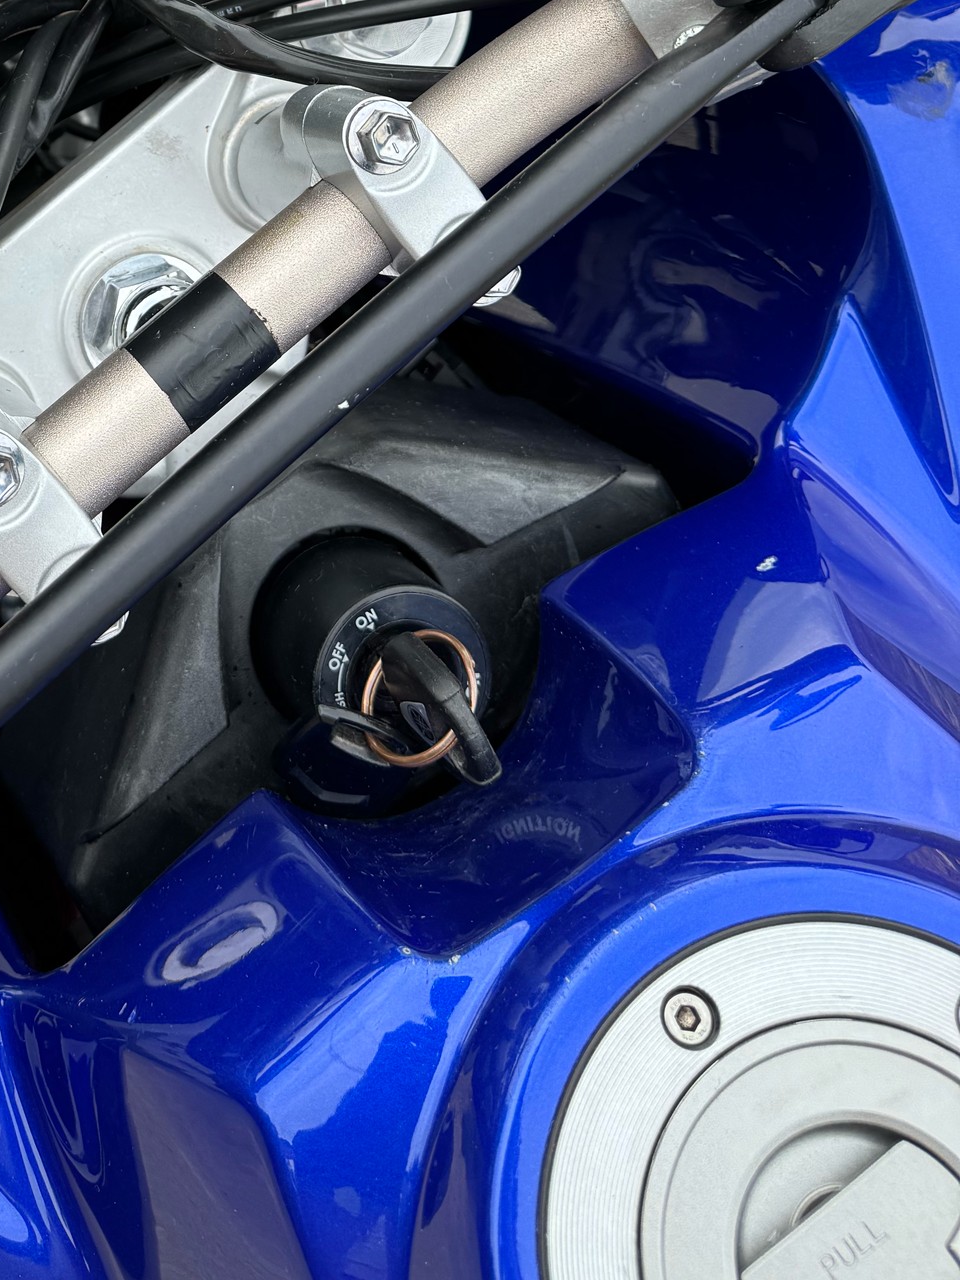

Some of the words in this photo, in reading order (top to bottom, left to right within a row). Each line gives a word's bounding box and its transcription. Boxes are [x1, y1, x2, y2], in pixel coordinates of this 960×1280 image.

[355, 608, 378, 630] ON
[328, 641, 347, 671] OFF
[819, 1220, 889, 1280] PULL
